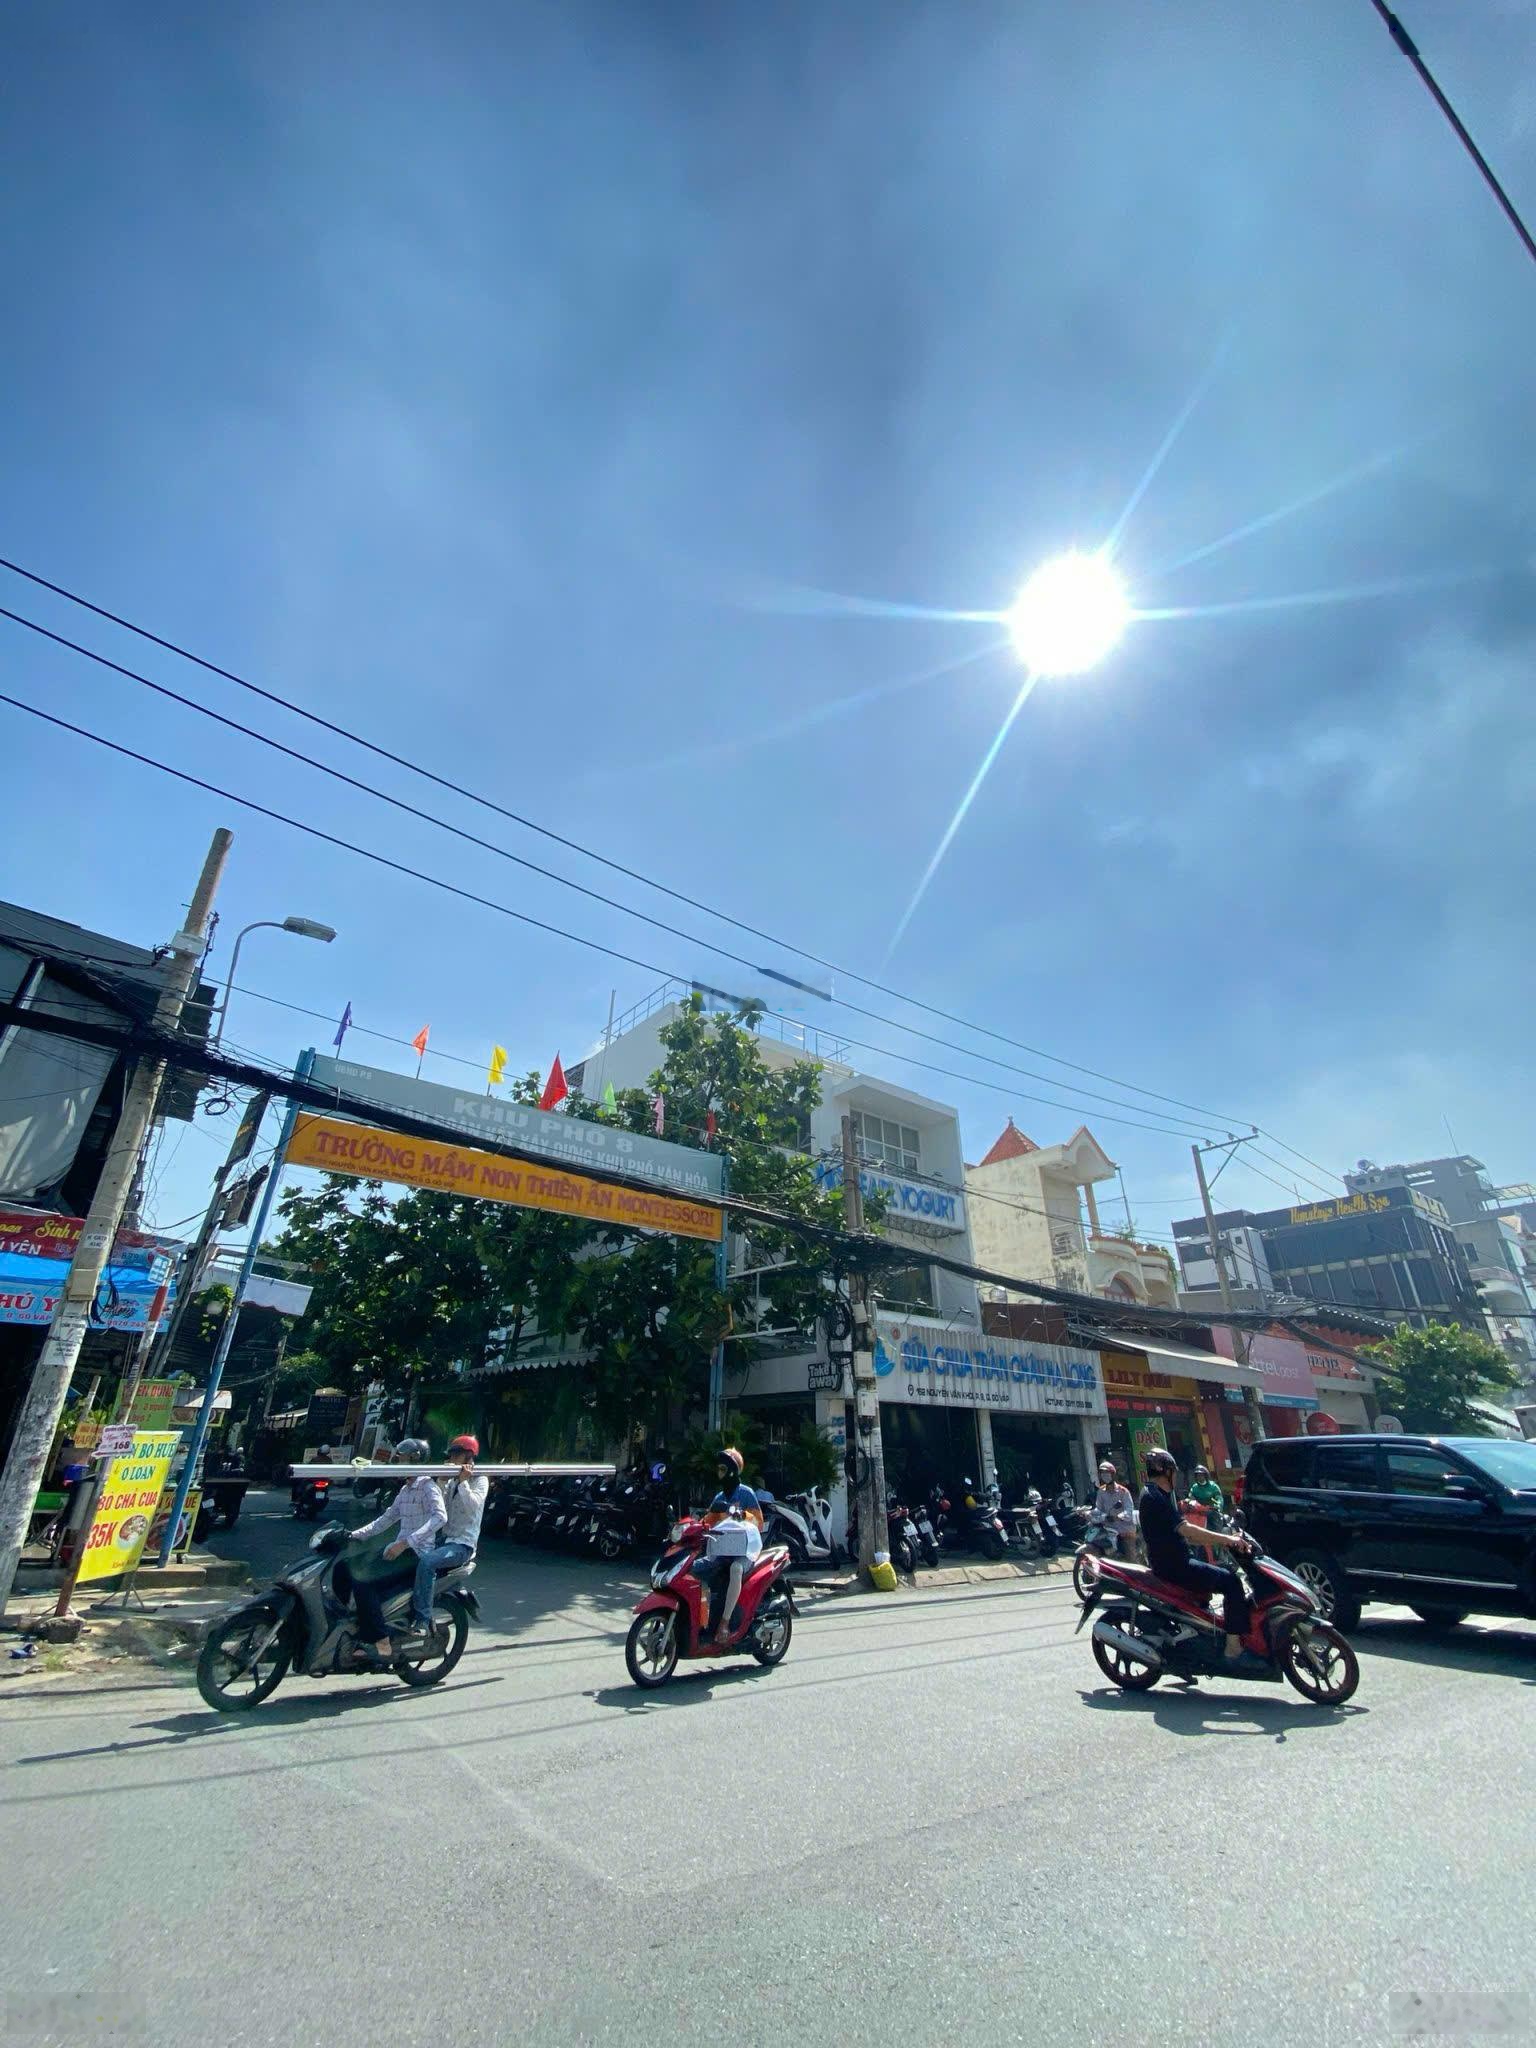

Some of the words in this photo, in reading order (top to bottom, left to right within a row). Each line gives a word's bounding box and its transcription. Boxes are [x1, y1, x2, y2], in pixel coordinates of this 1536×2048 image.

[453, 1097, 530, 1128] KHU
[540, 1117, 606, 1147] PHỐ
[615, 1137, 634, 1153] 8
[596, 1151, 625, 1172] KHU
[315, 1131, 416, 1170] TRƯỜNG
[420, 1150, 477, 1182] MẦM
[480, 1164, 521, 1191] NON
[526, 1174, 584, 1200] THIÊN
[587, 1182, 614, 1209] ÂN
[616, 1197, 715, 1227] MONTESSORI
[899, 1185, 956, 1223] YOGURT
[35, 1219, 71, 1239] Sinh
[10, 1239, 42, 1255] YÊN
[808, 1363, 830, 1378] Take
[933, 1344, 974, 1379] CHUA
[808, 1374, 841, 1392] away
[113, 1440, 131, 1450] 168
[130, 1464, 156, 1481] LOAN
[138, 1491, 158, 1507] CUA
[185, 1495, 198, 1509] UẾ
[87, 1521, 119, 1550] 35K
